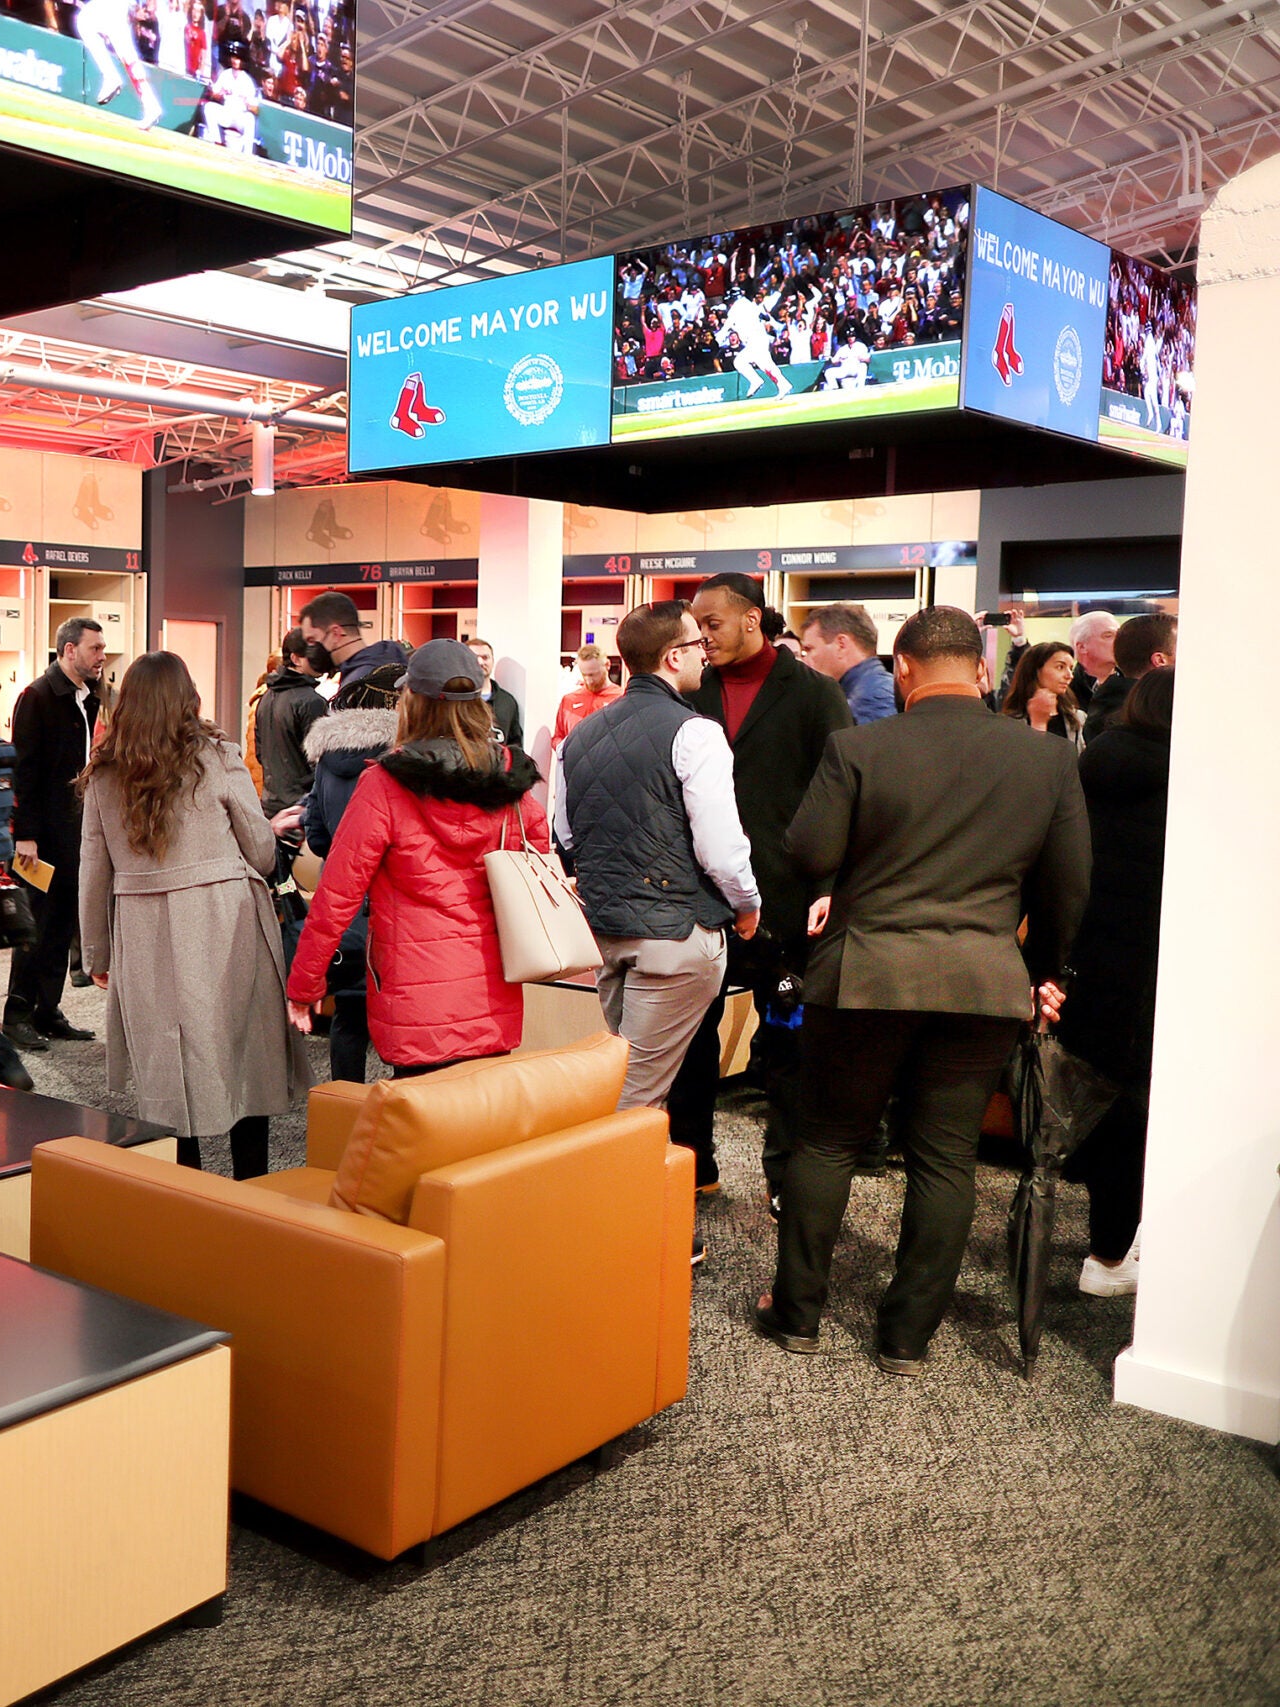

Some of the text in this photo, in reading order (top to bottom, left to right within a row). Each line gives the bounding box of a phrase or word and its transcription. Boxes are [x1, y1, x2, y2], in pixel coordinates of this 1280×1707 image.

[977, 228, 1106, 308] WELCOME MAYOR WU
[356, 290, 608, 357] WELCOME MAYOR WU
[45, 549, 90, 563] RAFAEL DEVERS
[125, 552, 139, 570] 11
[640, 557, 665, 570] REESE
[757, 551, 773, 570] 3
[781, 552, 837, 565] CONNOR WONG
[900, 546, 925, 564] 12
[389, 566, 436, 577] BRAYAN BELLO
[604, 555, 632, 573] 40
[277, 570, 312, 580] ZACK KELLY
[360, 565, 382, 581] 76
